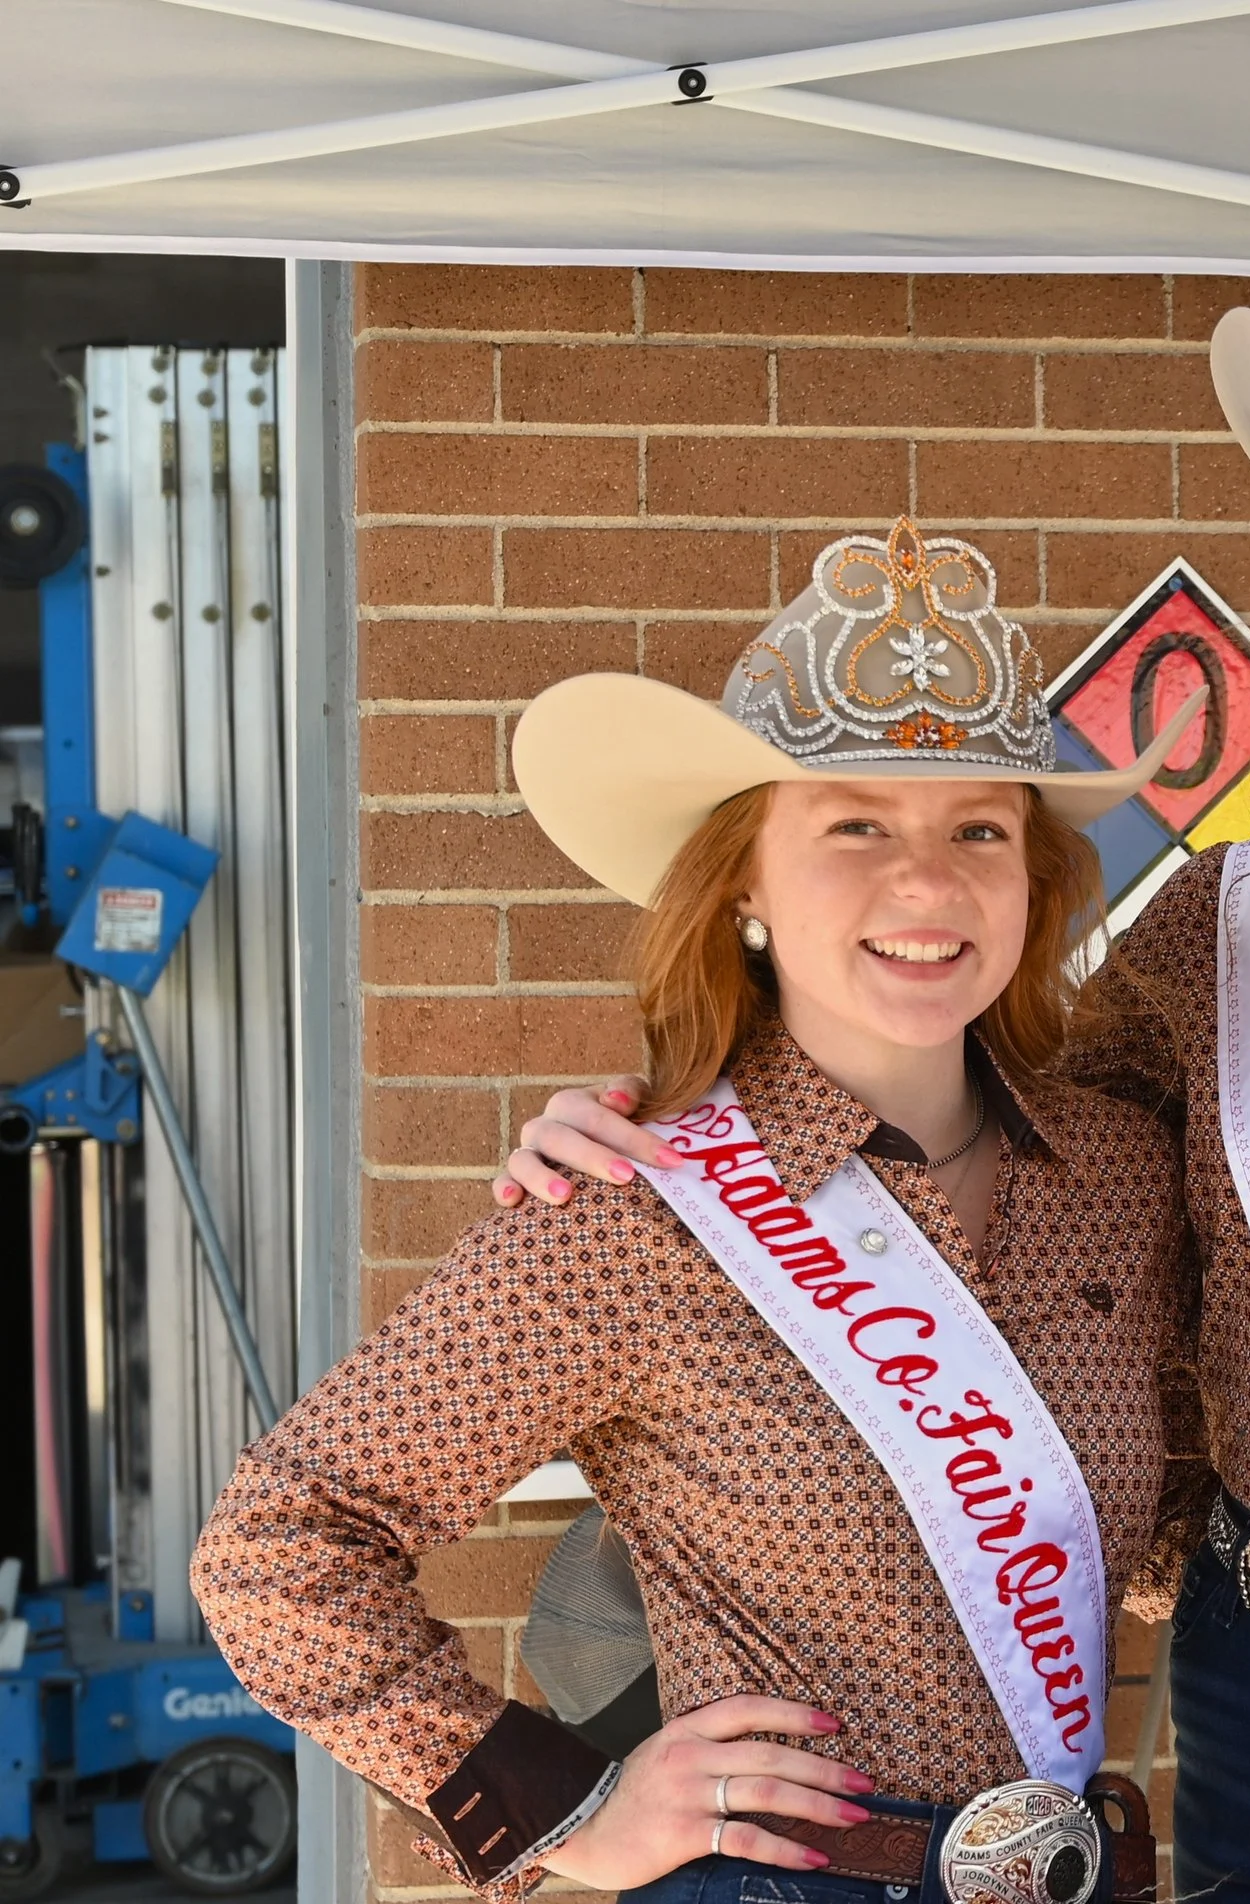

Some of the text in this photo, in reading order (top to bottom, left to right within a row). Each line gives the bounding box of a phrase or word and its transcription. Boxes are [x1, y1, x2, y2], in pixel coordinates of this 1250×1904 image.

[669, 1135, 1092, 1754] Adams Co. Fair Queen
[533, 1813, 583, 1854] CINCH
[956, 1817, 1085, 1861] ADAMS COUNTY FAIR QUEEN
[962, 1870, 1010, 1895] JORDYNN
